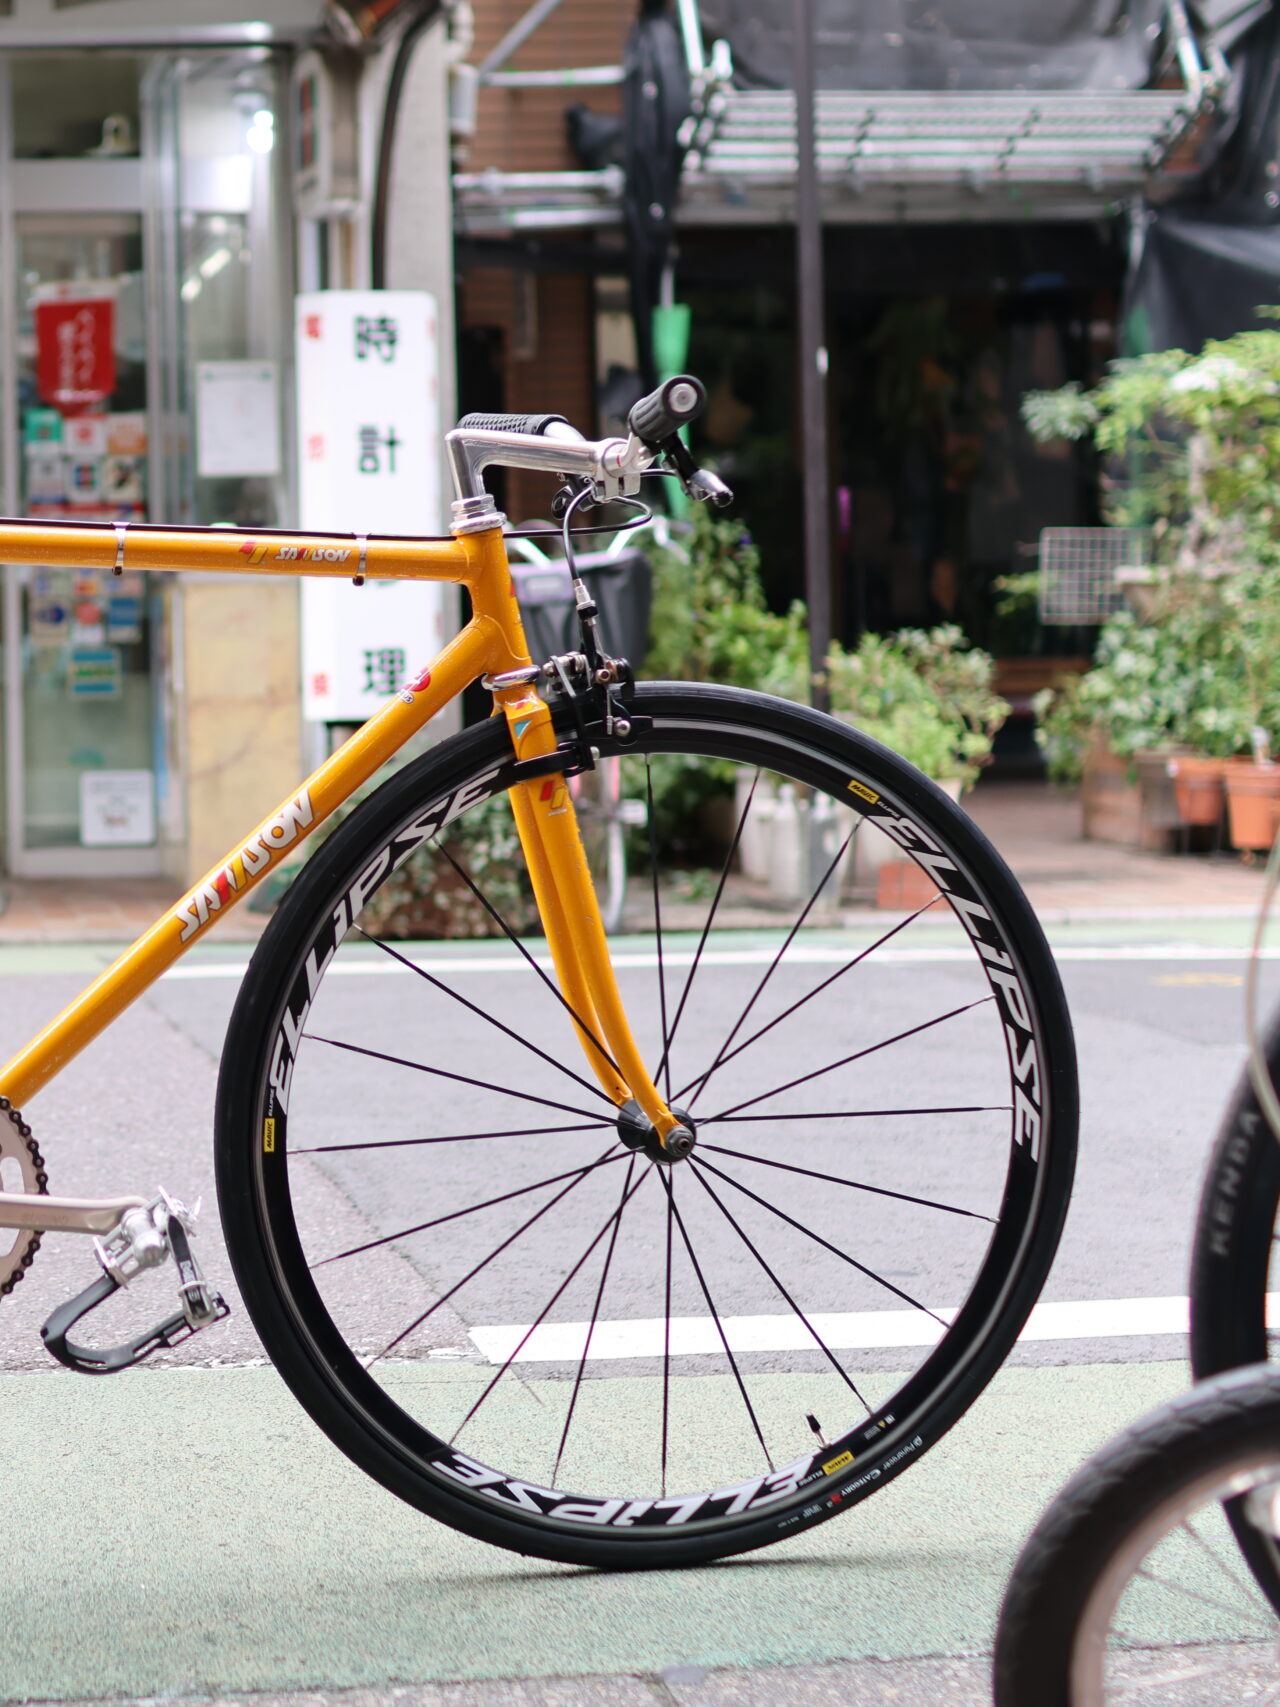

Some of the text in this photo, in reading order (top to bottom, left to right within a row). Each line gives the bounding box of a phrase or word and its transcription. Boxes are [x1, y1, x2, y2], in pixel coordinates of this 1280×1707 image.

[275, 546, 352, 562] SAMSON
[354, 312, 410, 695] 時計理
[850, 784, 877, 802] MAVIC
[176, 787, 314, 944] SAMSON
[269, 767, 500, 1116] ELLIPSE
[868, 815, 1042, 1162] ELLIPSE
[265, 1120, 274, 1150] MAVIC
[431, 1453, 815, 1527] ELLIPSE
